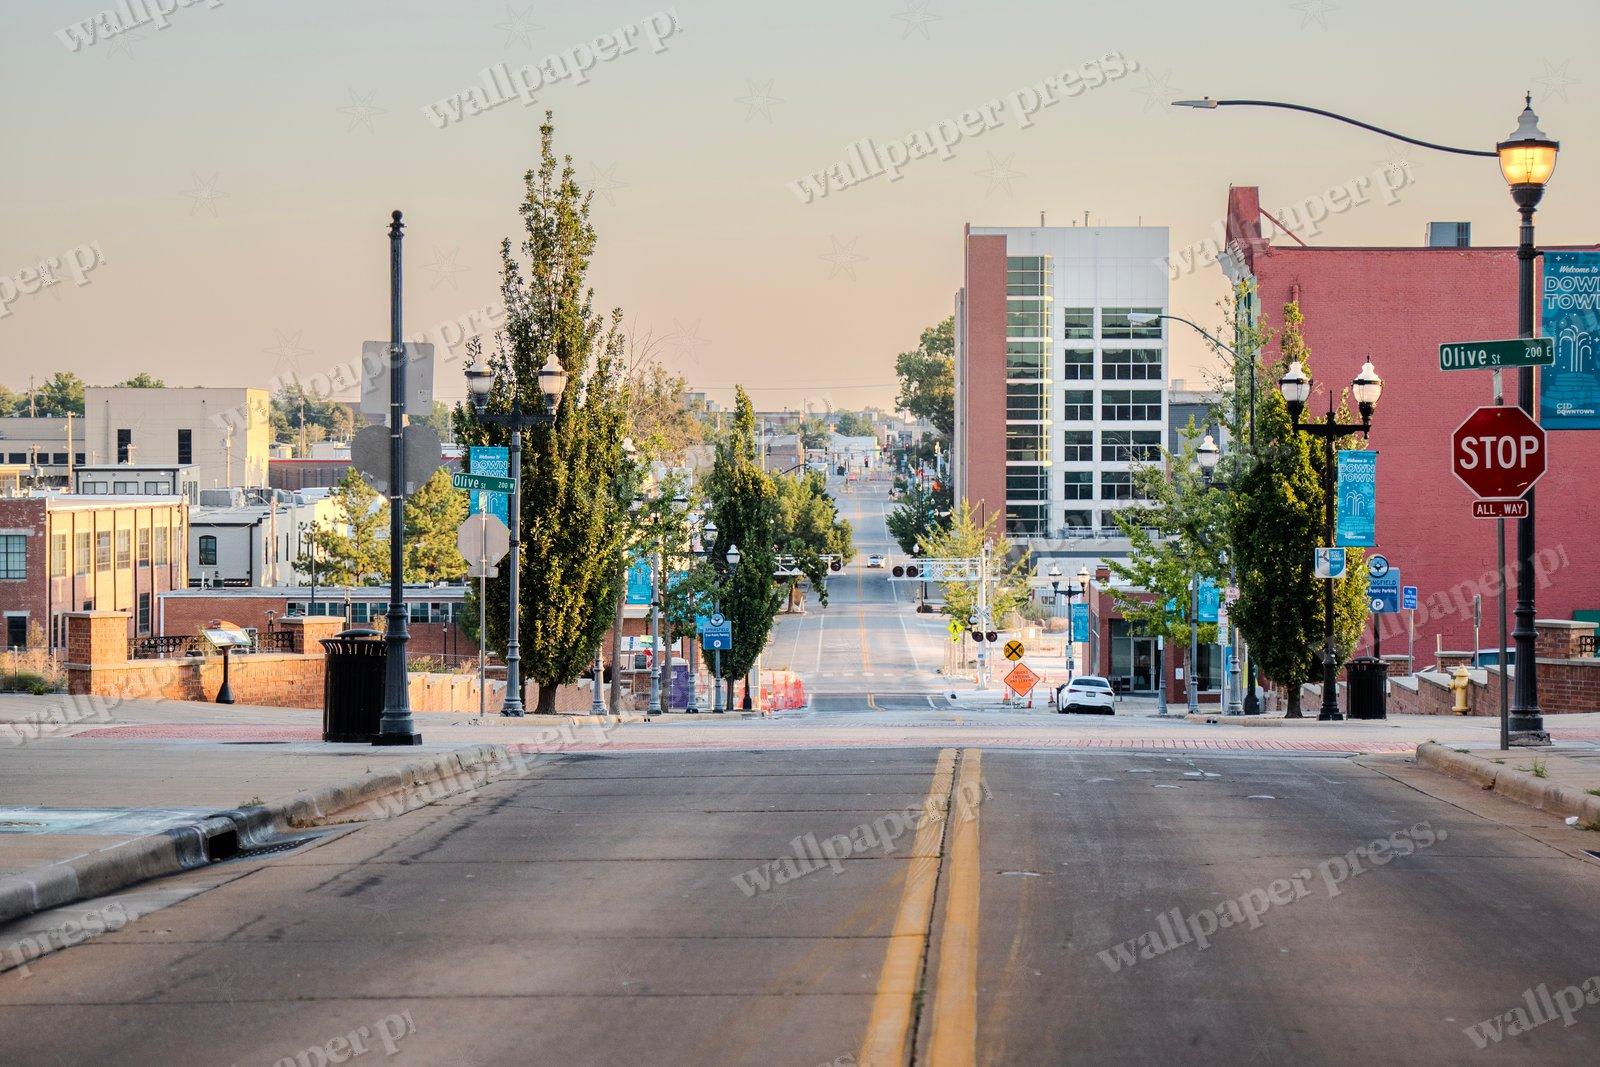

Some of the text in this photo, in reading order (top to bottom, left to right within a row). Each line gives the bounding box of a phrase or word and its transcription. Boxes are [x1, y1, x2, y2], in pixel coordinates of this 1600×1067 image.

[1559, 265, 1598, 274] Welcome to
[1442, 345, 1552, 367] Olive St 200 E
[1460, 435, 1539, 470] STOP
[472, 461, 508, 470] DOWN
[1339, 464, 1375, 473] DOWN
[454, 474, 479, 488] Olive
[1340, 473, 1375, 482] TOWN
[1477, 504, 1523, 515] ALL WAY
